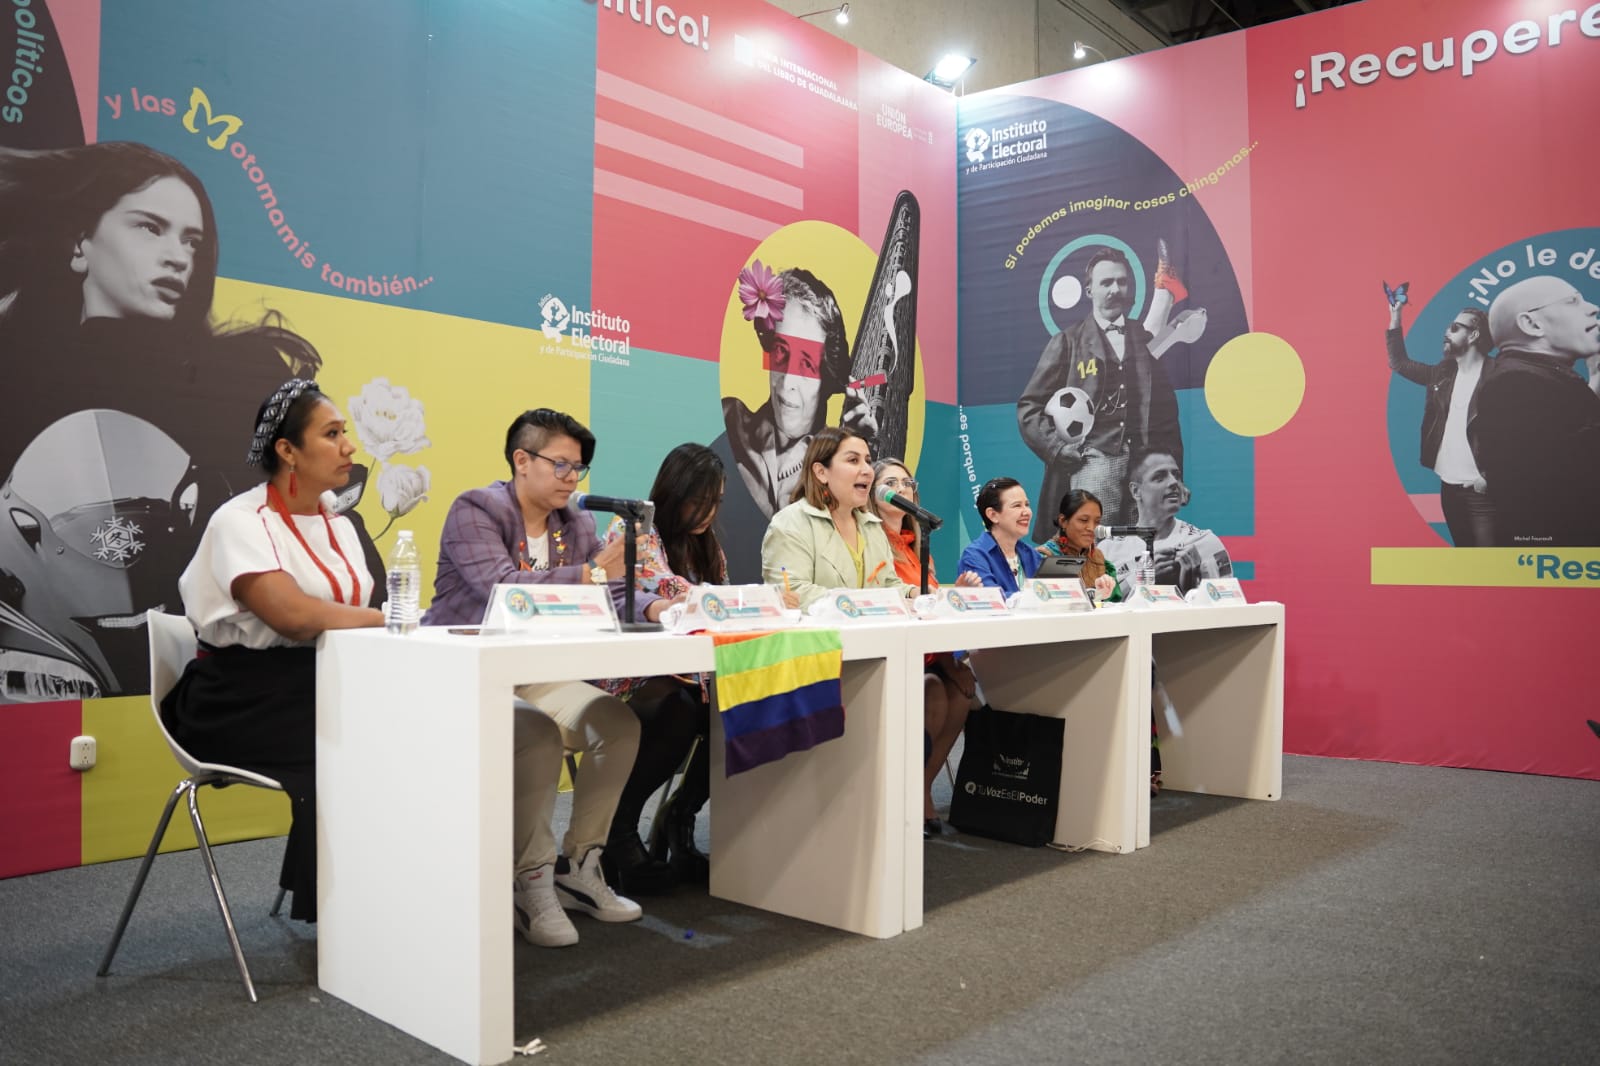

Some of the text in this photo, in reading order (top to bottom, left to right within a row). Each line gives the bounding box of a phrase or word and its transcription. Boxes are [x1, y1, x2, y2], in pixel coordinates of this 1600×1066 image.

[603, 0, 709, 51] tica!
[780, 58, 838, 90] INTERNACIONAL
[773, 67, 796, 84] LIBRO
[797, 77, 807, 89] DE
[808, 83, 858, 111] GUADALAJARA
[876, 113, 913, 140] EUROPEA
[992, 120, 1047, 143] Instituto
[992, 133, 1047, 159] Electoral
[970, 165, 978, 173] de
[979, 157, 1015, 171] Participación
[1017, 152, 1048, 163] Ciudadana
[104, 95, 122, 119] y
[131, 87, 176, 116] las
[321, 263, 434, 296] también...
[1005, 254, 1018, 270] Si
[1016, 208, 1068, 256] podemos
[1069, 195, 1131, 213] imaginar
[1134, 192, 1176, 211] cosas
[1525, 244, 1558, 268] le
[571, 304, 630, 334] Instituto
[571, 327, 630, 355] Electoral
[1077, 358, 1099, 379] 14
[959, 434, 977, 482] porque
